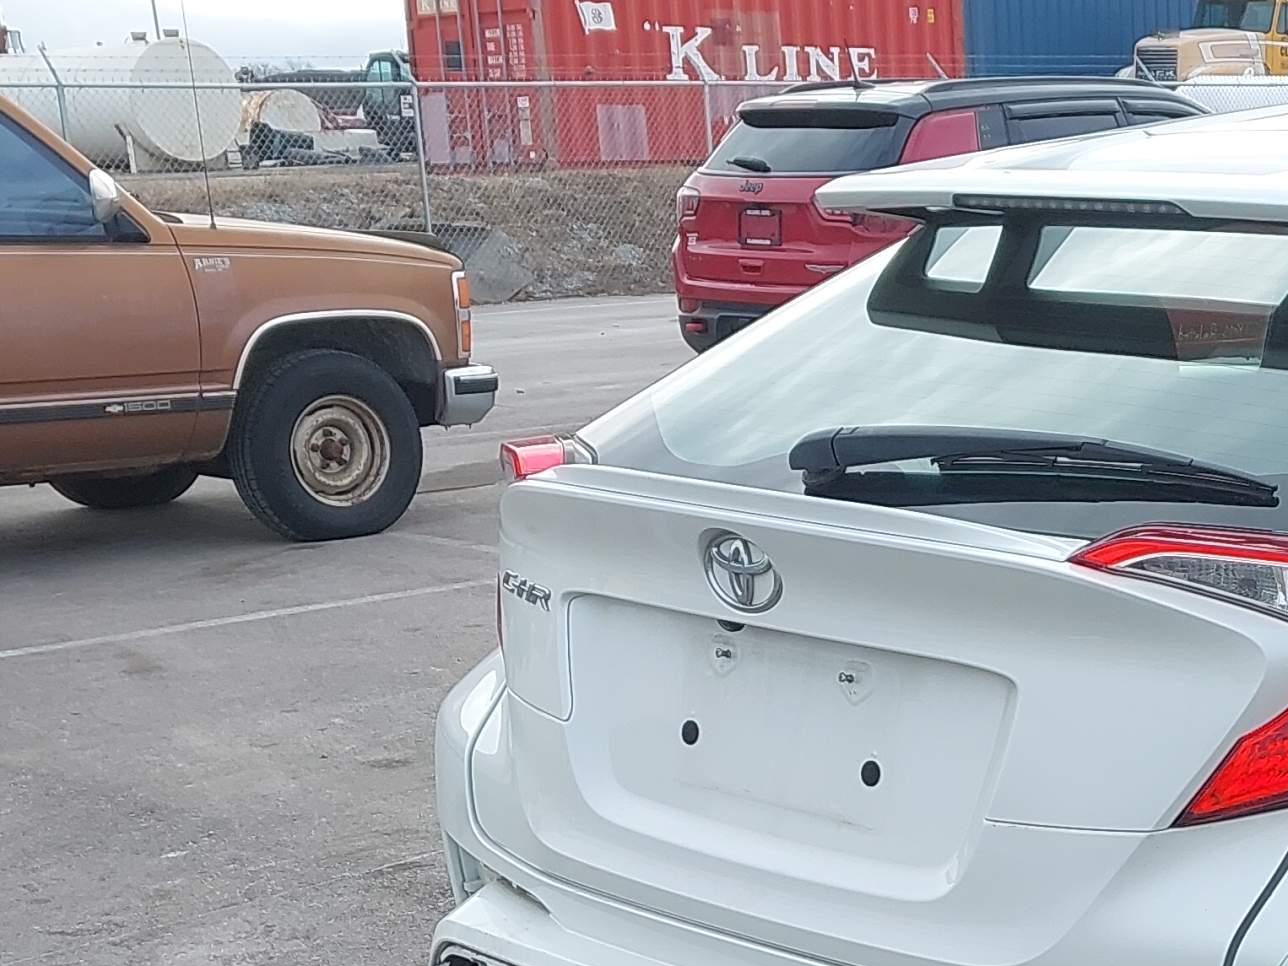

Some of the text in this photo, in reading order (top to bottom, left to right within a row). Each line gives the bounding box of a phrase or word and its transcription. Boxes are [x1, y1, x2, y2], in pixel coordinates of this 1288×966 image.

[742, 44, 877, 81] LINE
[738, 180, 764, 195] Jeep
[123, 400, 171, 412] 1500
